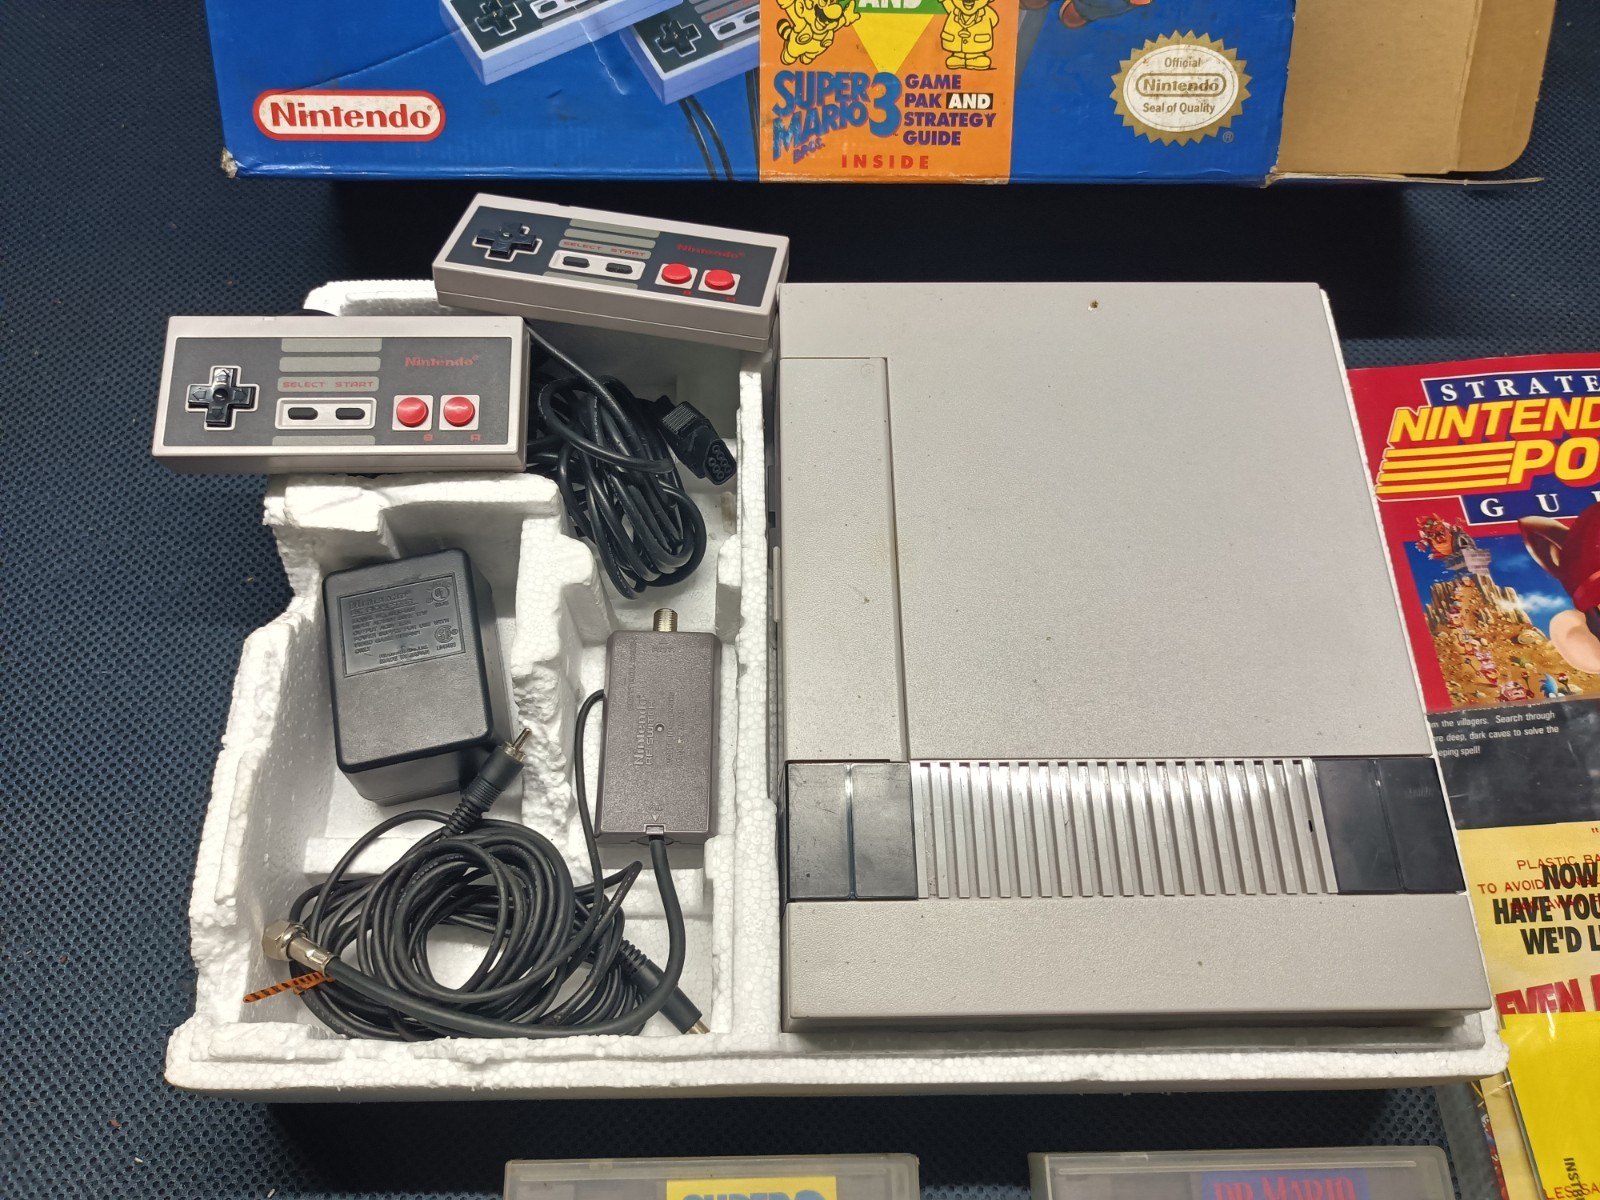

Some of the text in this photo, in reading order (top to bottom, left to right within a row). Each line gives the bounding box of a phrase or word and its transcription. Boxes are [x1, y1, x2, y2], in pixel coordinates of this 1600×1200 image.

[1164, 57, 1201, 69] Official
[905, 74, 961, 89] GAME
[1143, 78, 1220, 93] Nintendo
[772, 70, 870, 117] SUPER
[905, 94, 992, 109] PAK AND
[869, 71, 902, 138] 3
[1143, 103, 1216, 115] Seal of Quality
[270, 102, 433, 129] Nintendo
[904, 112, 997, 127] STRATEGY
[772, 101, 869, 161] MARIO
[903, 131, 961, 145] GUIDE
[841, 154, 929, 169] INSIDE
[563, 241, 647, 257] SELECT START
[404, 356, 474, 367] Nintendo
[1508, 436, 1600, 485] PO
[1480, 490, 1600, 517] GU
[1441, 719, 1454, 728] the
[1457, 717, 1490, 729] villagers.
[1495, 713, 1523, 724] Search
[1526, 710, 1555, 722] through
[1446, 733, 1467, 744] deep,
[1469, 731, 1486, 740] dark
[1488, 731, 1511, 739] caves
[1513, 729, 1522, 737] to
[1524, 726, 1544, 735] solve
[1546, 725, 1559, 734] the
[1460, 746, 1481, 756] spell!
[1517, 856, 1578, 870] PLASTIC
[1541, 862, 1598, 890] NOW
[1477, 882, 1497, 894] TO
[1504, 879, 1546, 893] AVOID
[1492, 896, 1553, 924] HAVE
[1520, 926, 1582, 955] WE'D
[1495, 978, 1586, 1014] EVEN
